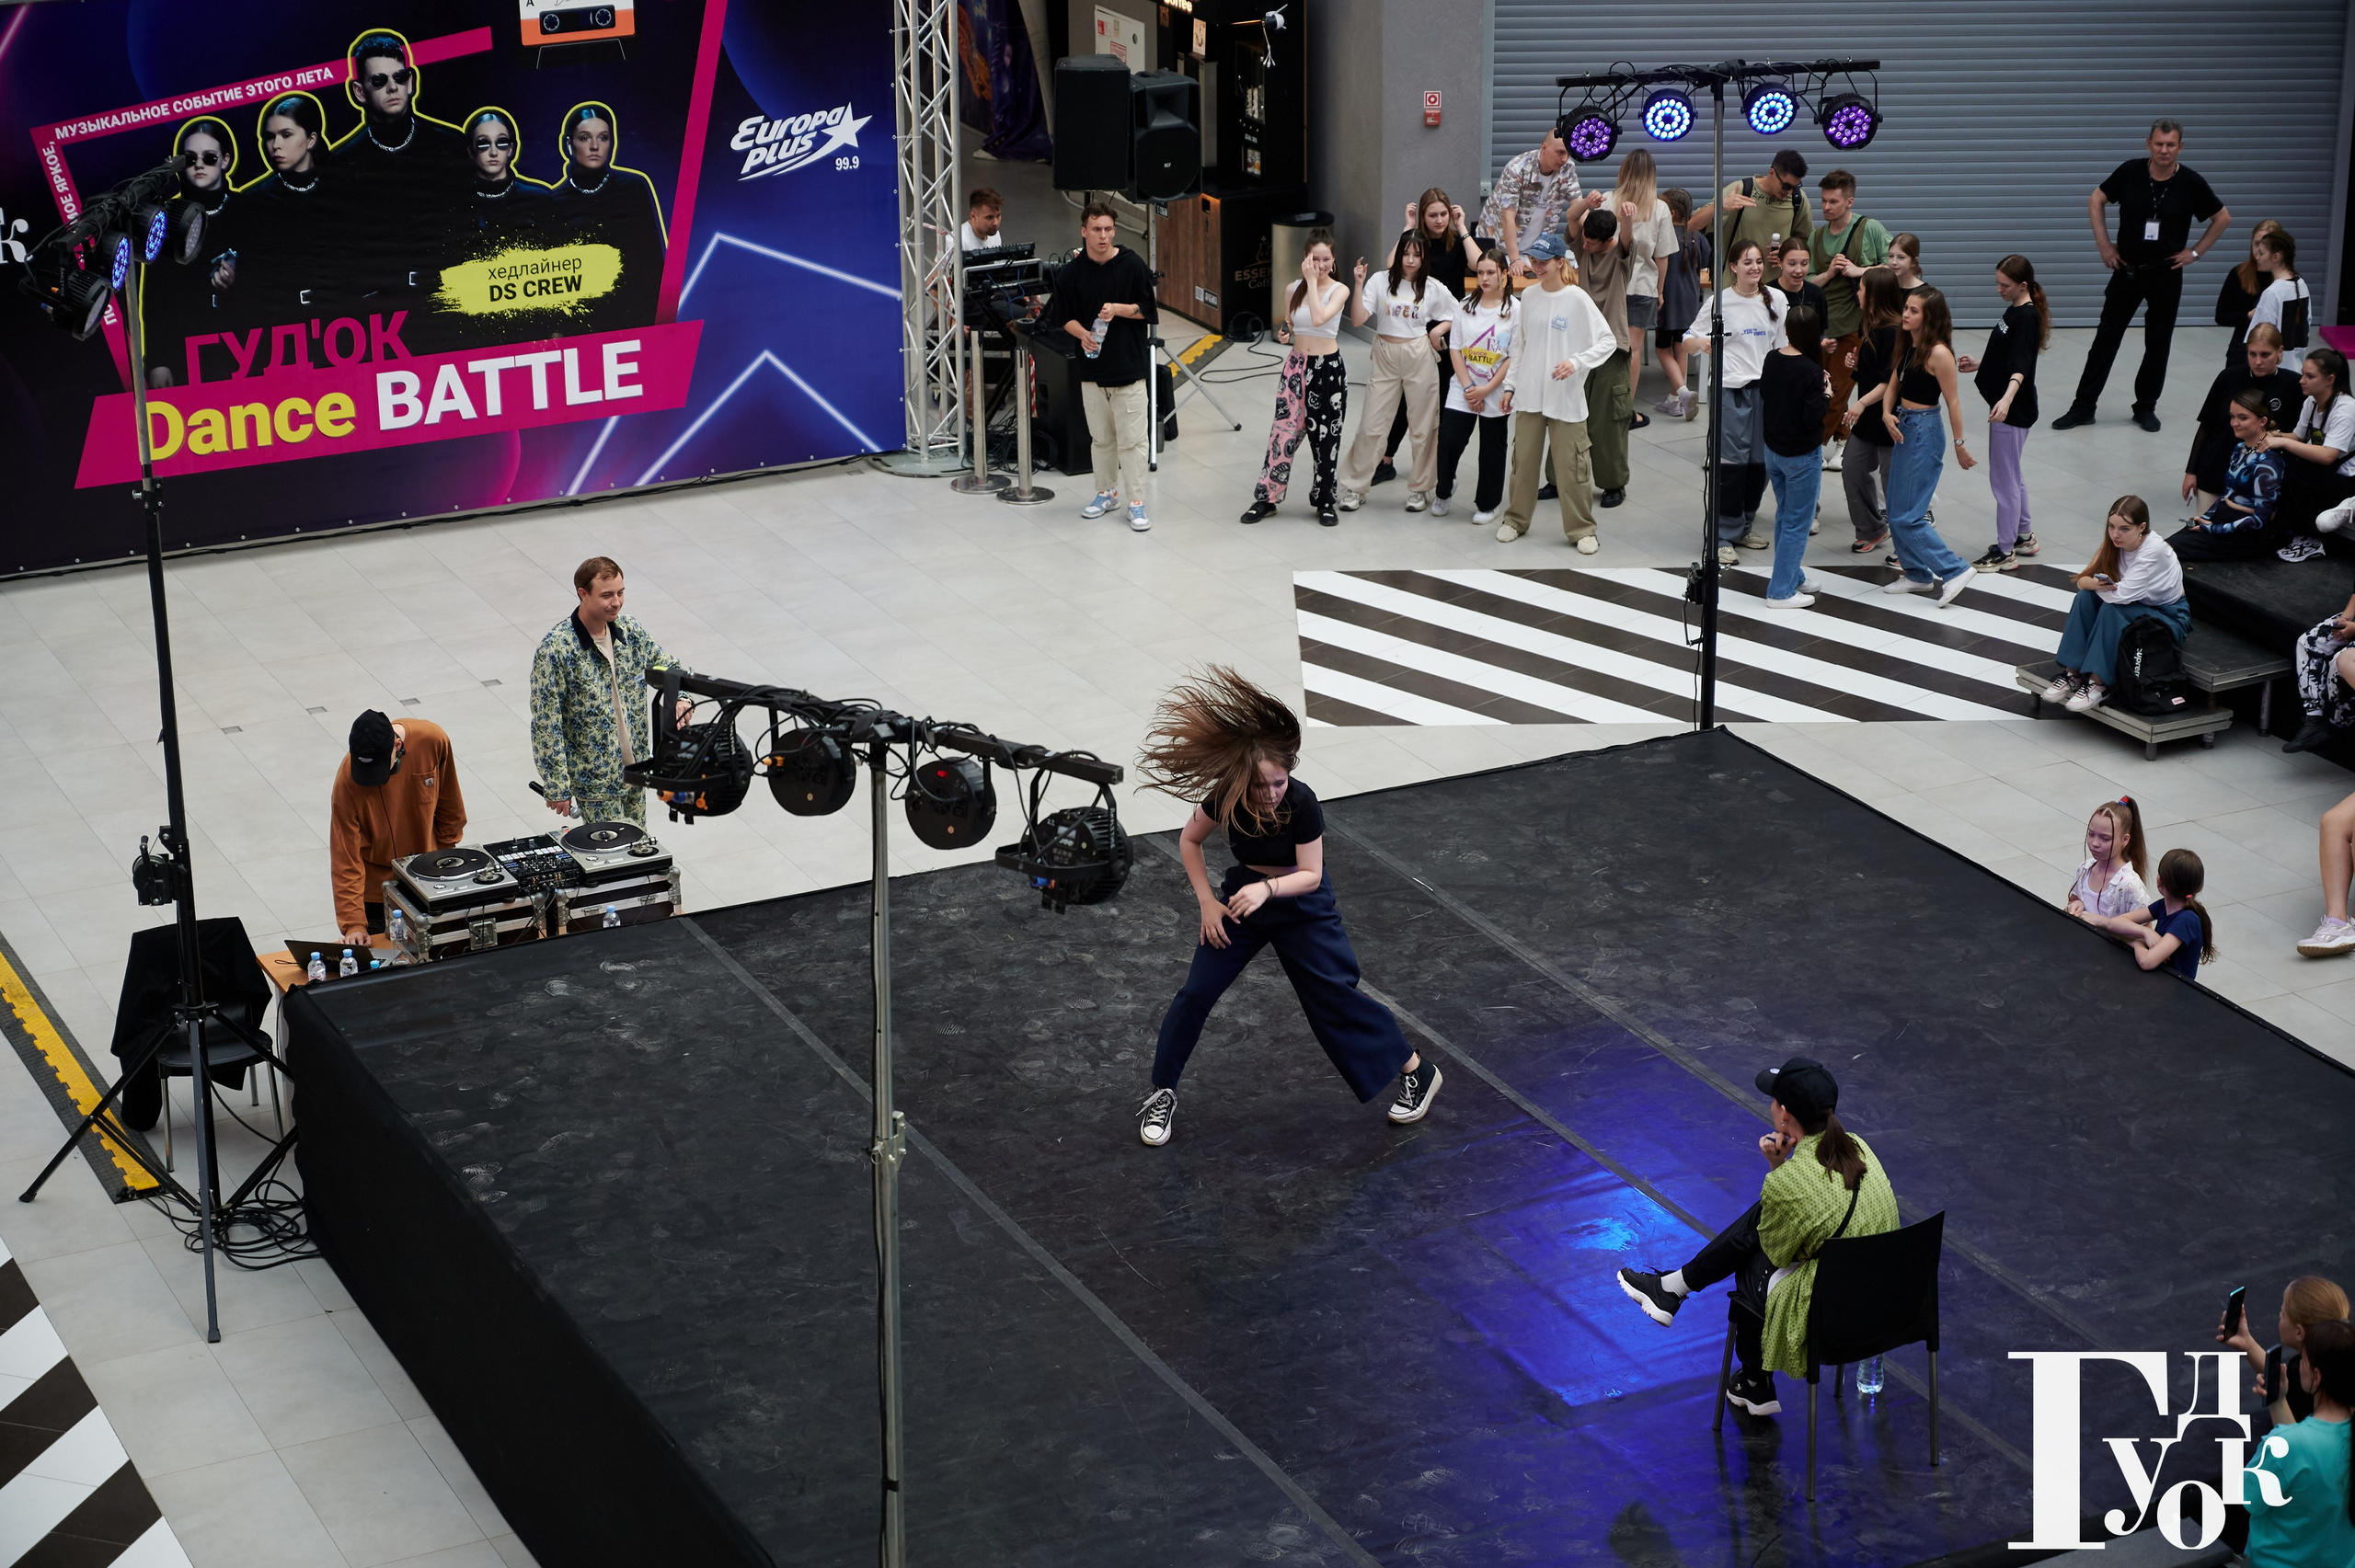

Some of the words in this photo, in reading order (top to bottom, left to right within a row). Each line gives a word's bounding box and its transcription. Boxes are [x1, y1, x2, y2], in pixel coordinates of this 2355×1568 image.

[54, 103, 171, 140] МУЗЫКАЛЬНОЕ
[172, 86, 244, 113] СОБЫТИЕ
[246, 76, 293, 97] ЭТОГО
[296, 66, 334, 86] ЛЕТА
[41, 141, 70, 193] ЯРКОЕ,
[835, 155, 860, 171] 99.9
[488, 258, 582, 280] хедлайнер
[489, 282, 517, 303] DS
[523, 274, 582, 298] CREW
[144, 391, 357, 462] Dance
[375, 338, 644, 432] BATTLE
